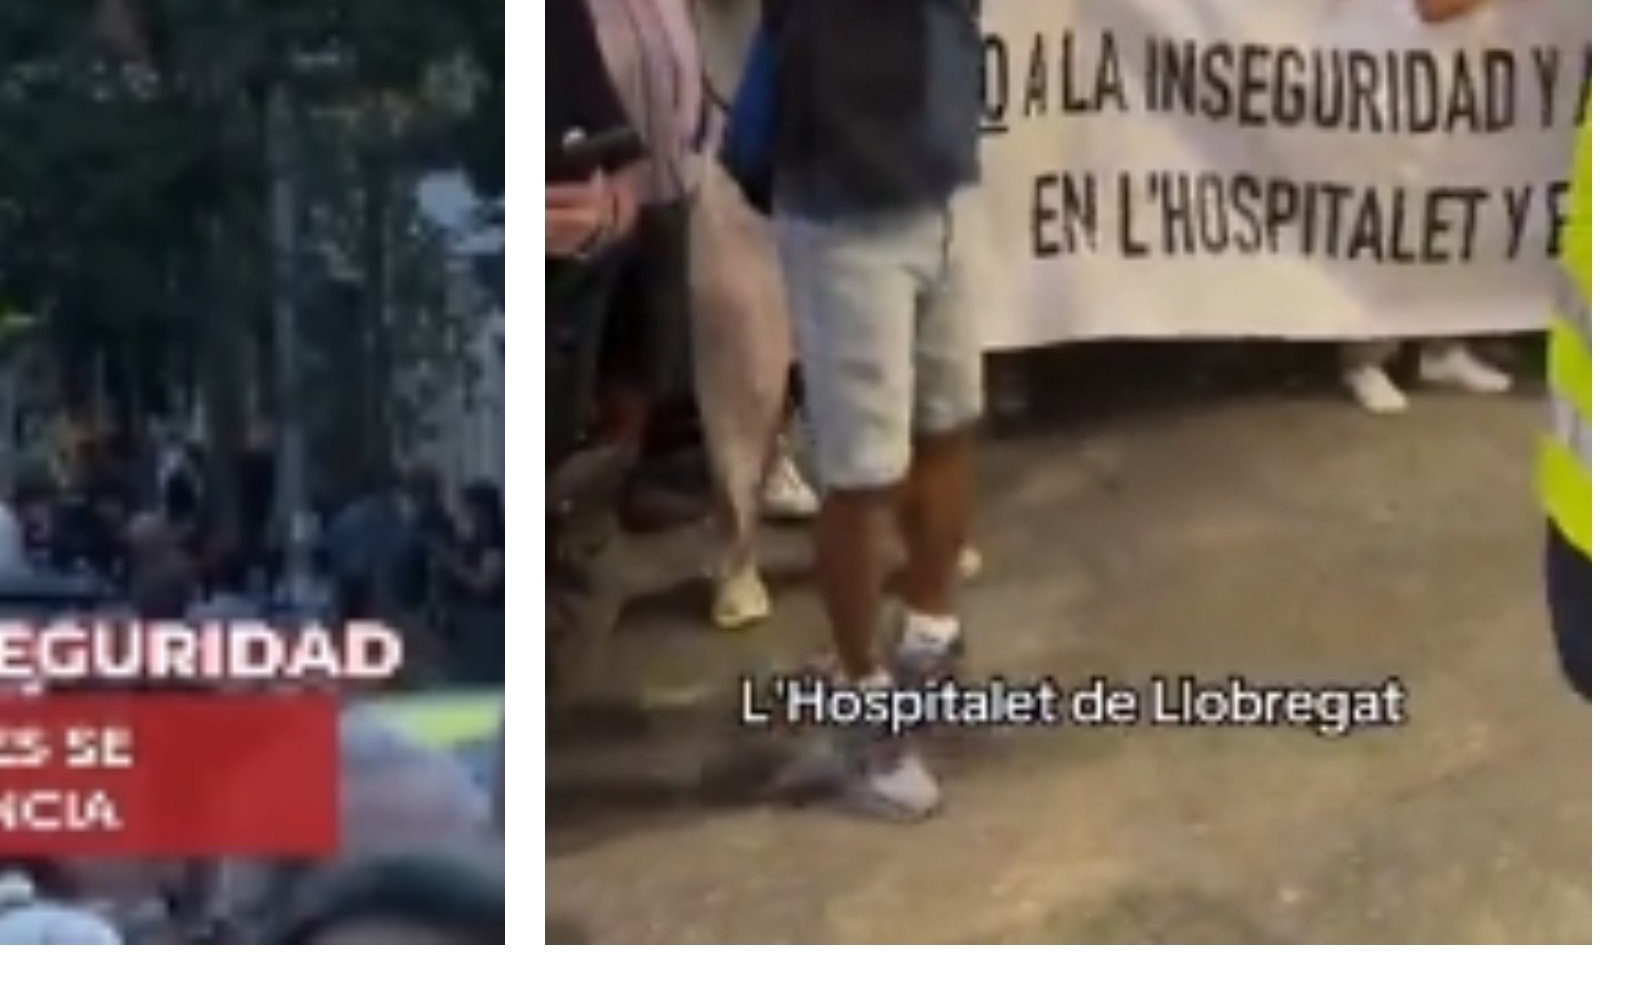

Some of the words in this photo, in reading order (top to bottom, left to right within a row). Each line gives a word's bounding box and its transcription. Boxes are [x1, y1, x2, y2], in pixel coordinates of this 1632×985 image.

[1023, 32, 1048, 117] A
[1062, 29, 1128, 113] LA
[1144, 39, 1517, 134] INSEGURIDAD
[1530, 46, 1559, 130] Y
[1032, 172, 1098, 257] EN
[1119, 172, 1491, 265] L'HOSPITALET
[1504, 182, 1535, 261] Y
